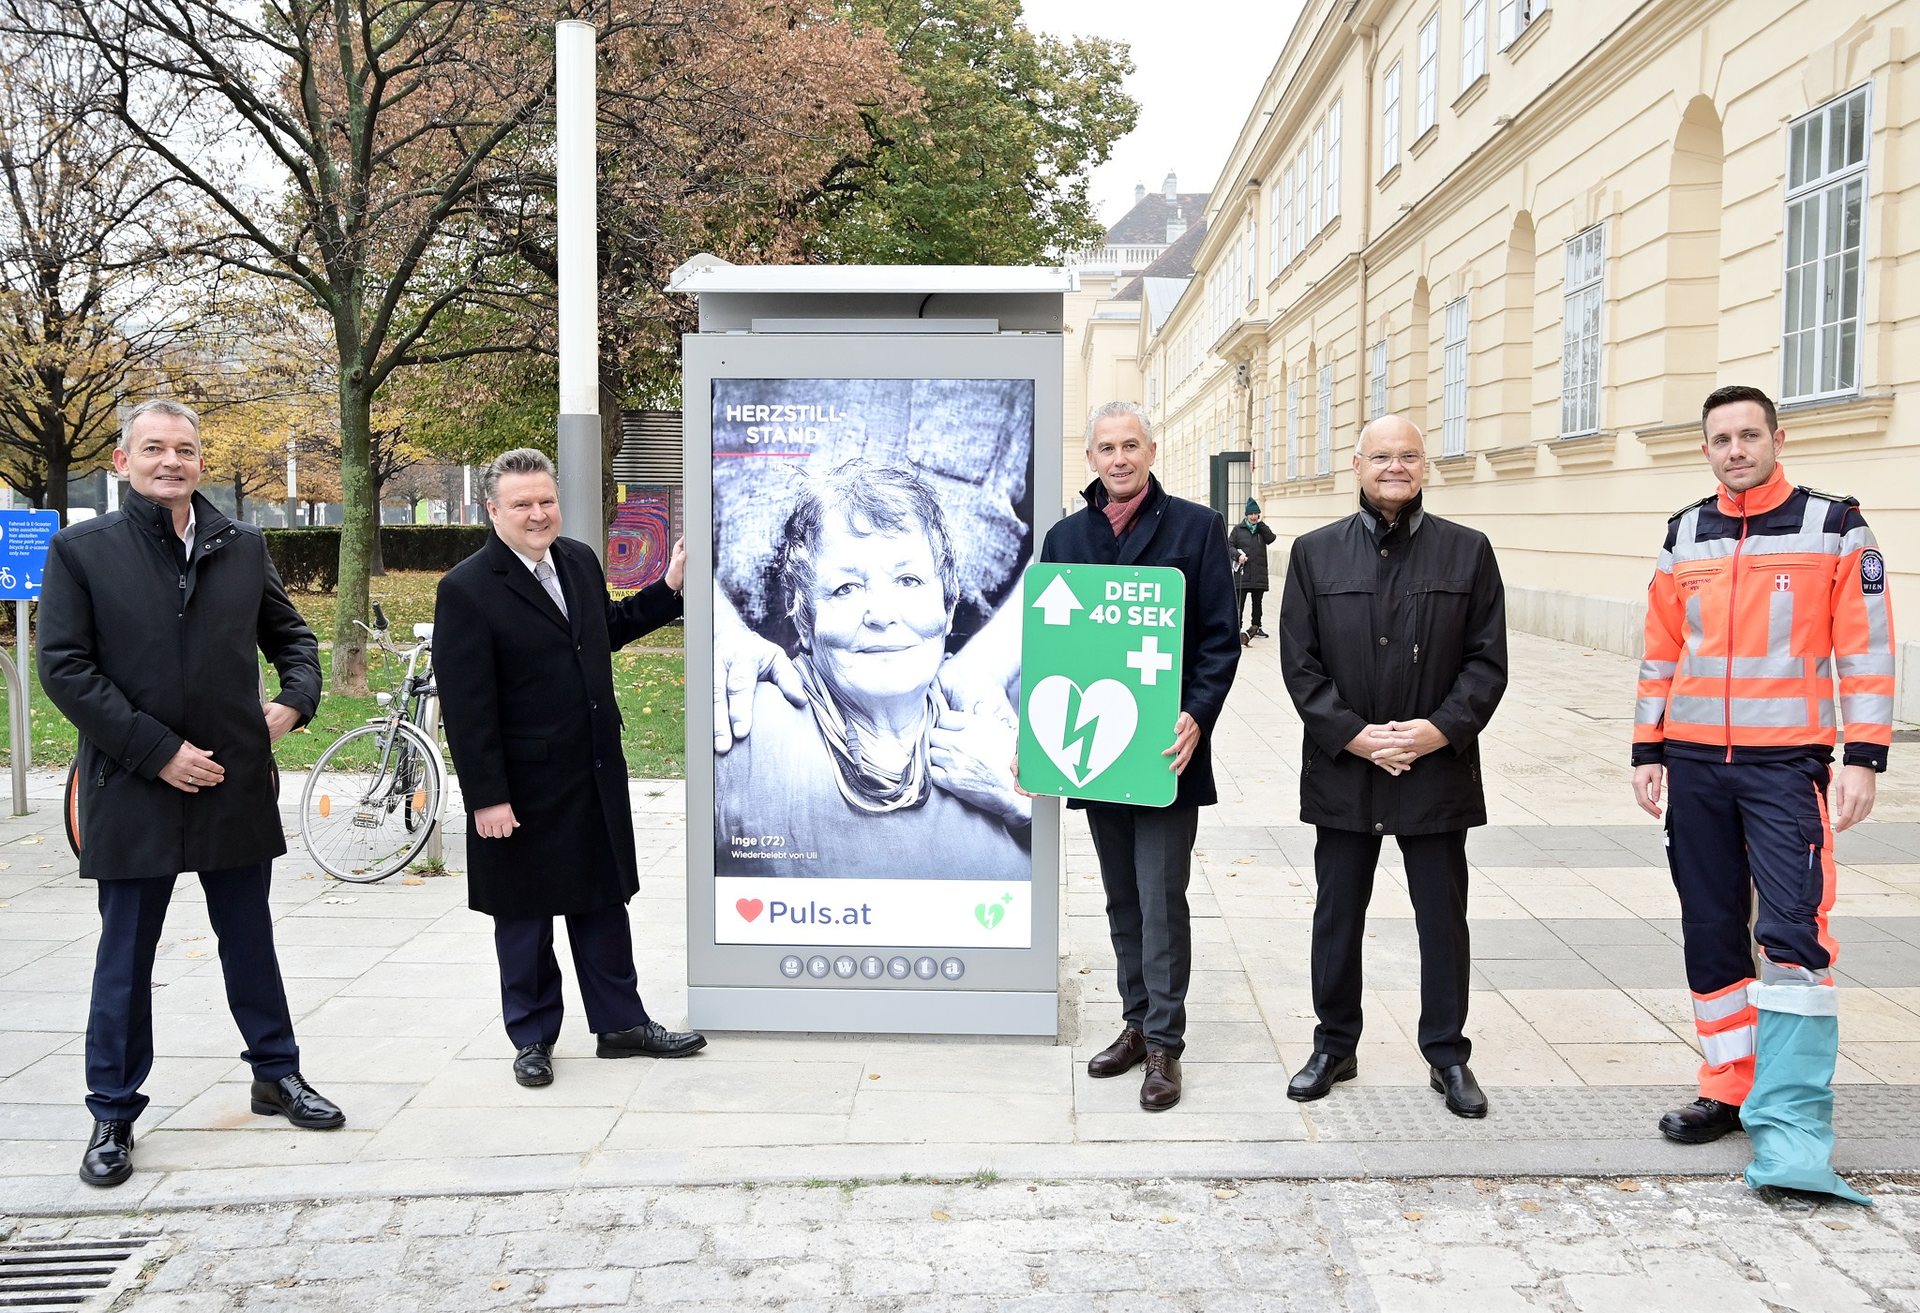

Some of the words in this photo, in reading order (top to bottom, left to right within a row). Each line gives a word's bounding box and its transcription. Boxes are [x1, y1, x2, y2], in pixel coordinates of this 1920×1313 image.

[726, 404, 848, 422] HERZSTILL-
[746, 426, 822, 444] STAND
[1105, 581, 1162, 603] DEFI
[1088, 604, 1121, 624] 40
[1127, 606, 1176, 628] SEK
[732, 836, 757, 847] Inge
[761, 836, 785, 847] (72)
[731, 851, 787, 859] Wiederbelebt
[769, 900, 872, 925] Puls.at
[785, 957, 960, 975] gewista
